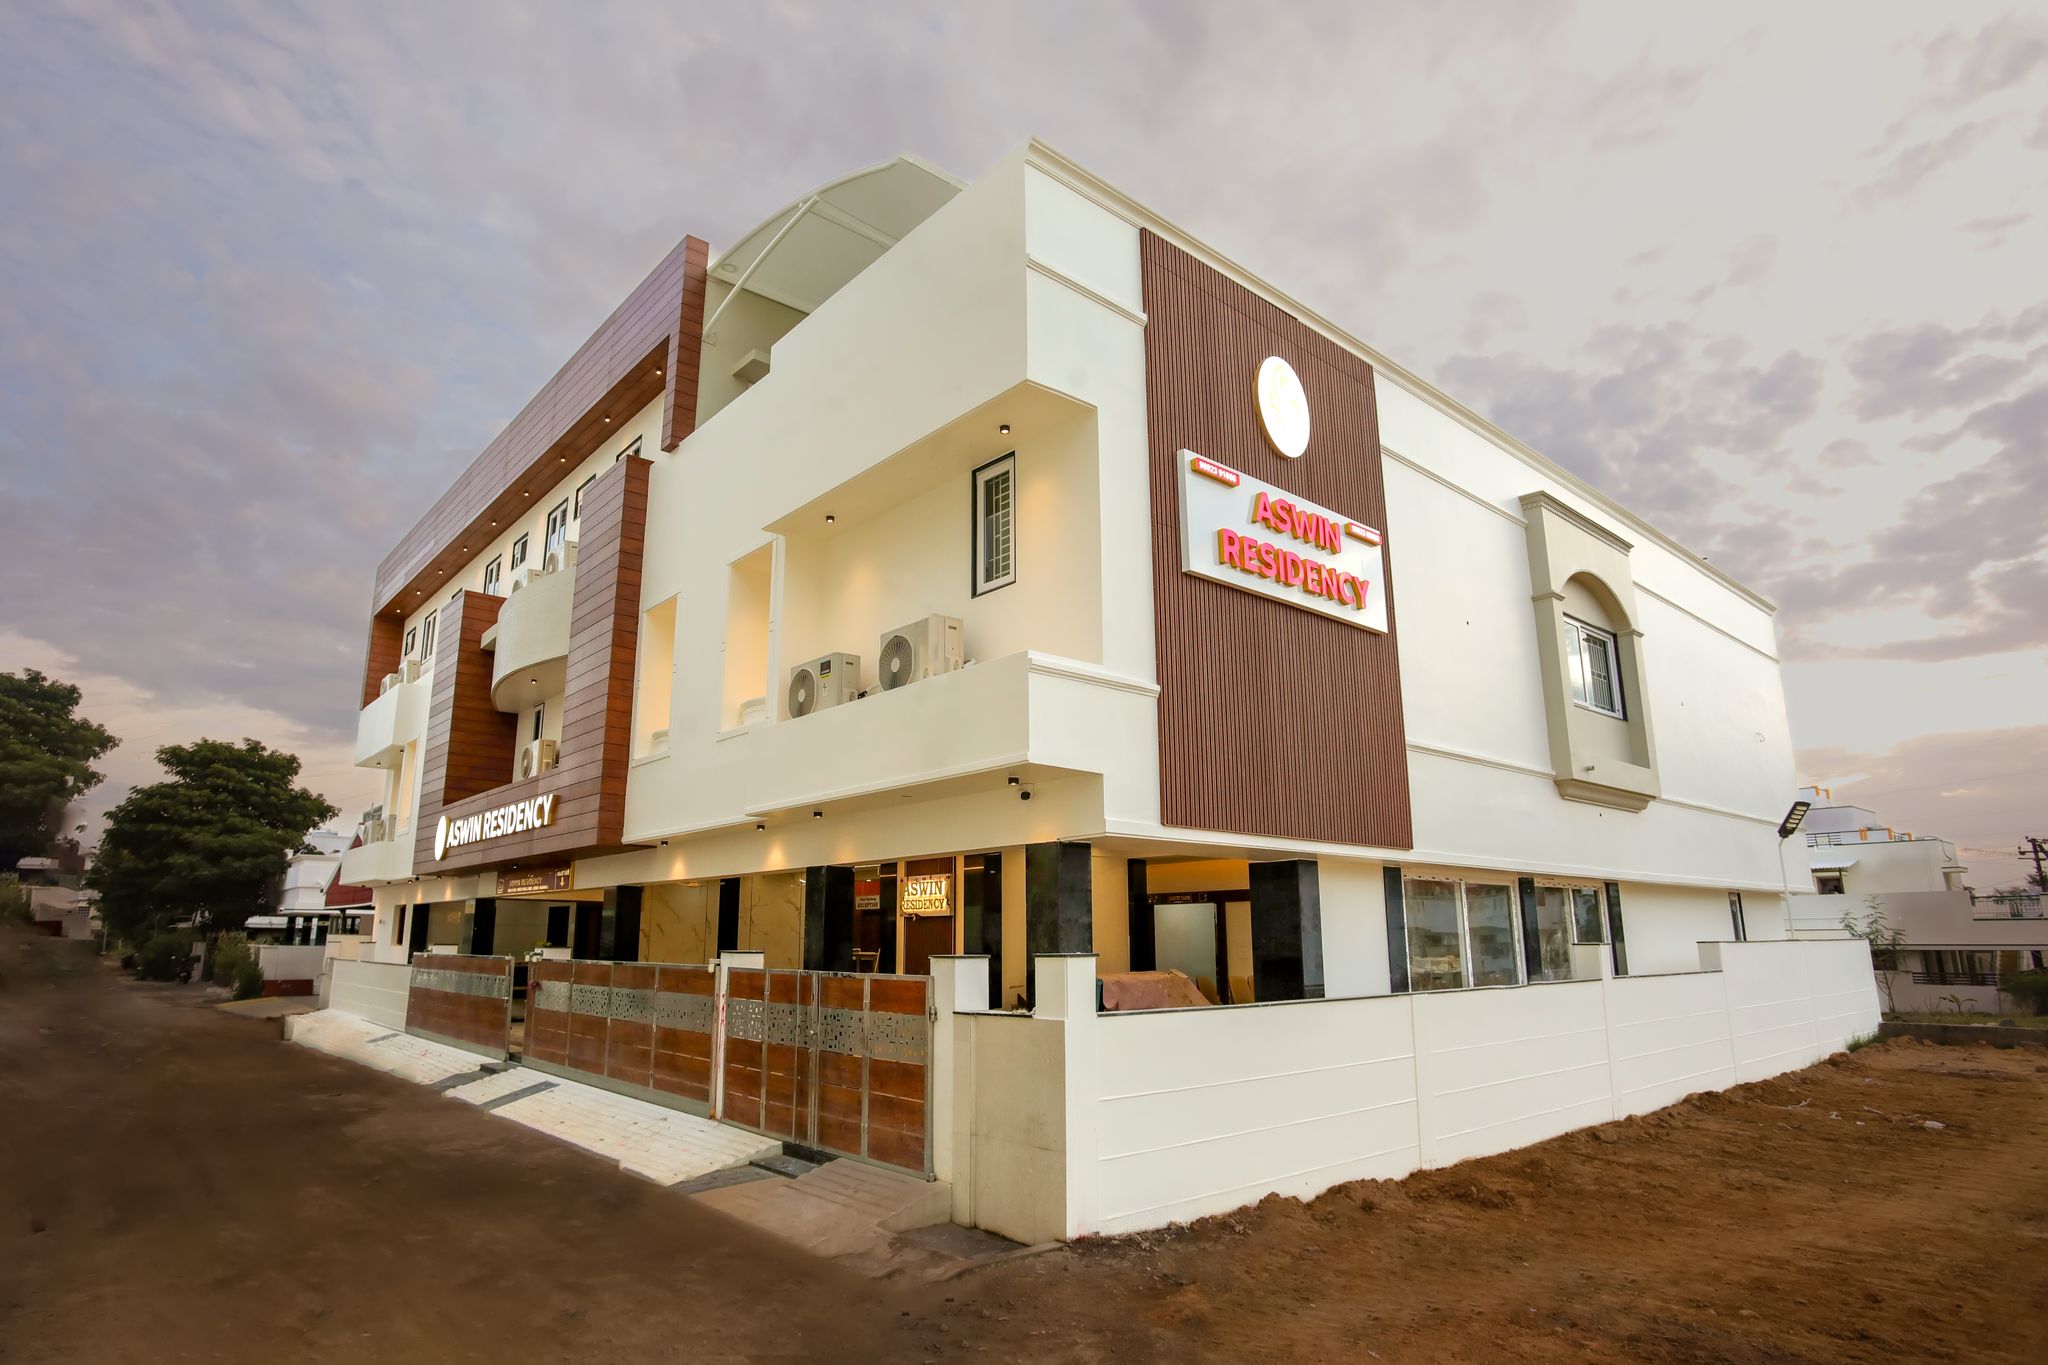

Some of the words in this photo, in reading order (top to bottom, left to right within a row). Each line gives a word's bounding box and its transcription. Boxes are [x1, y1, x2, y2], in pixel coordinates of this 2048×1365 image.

[1252, 492, 1341, 554] ASWIN
[1218, 528, 1369, 610] RESIDENCY
[446, 814, 482, 848] ASWIN
[482, 794, 553, 839] RESIDENCY
[902, 898, 944, 910] RESIDENCY
[904, 881, 943, 896] ASWIN
